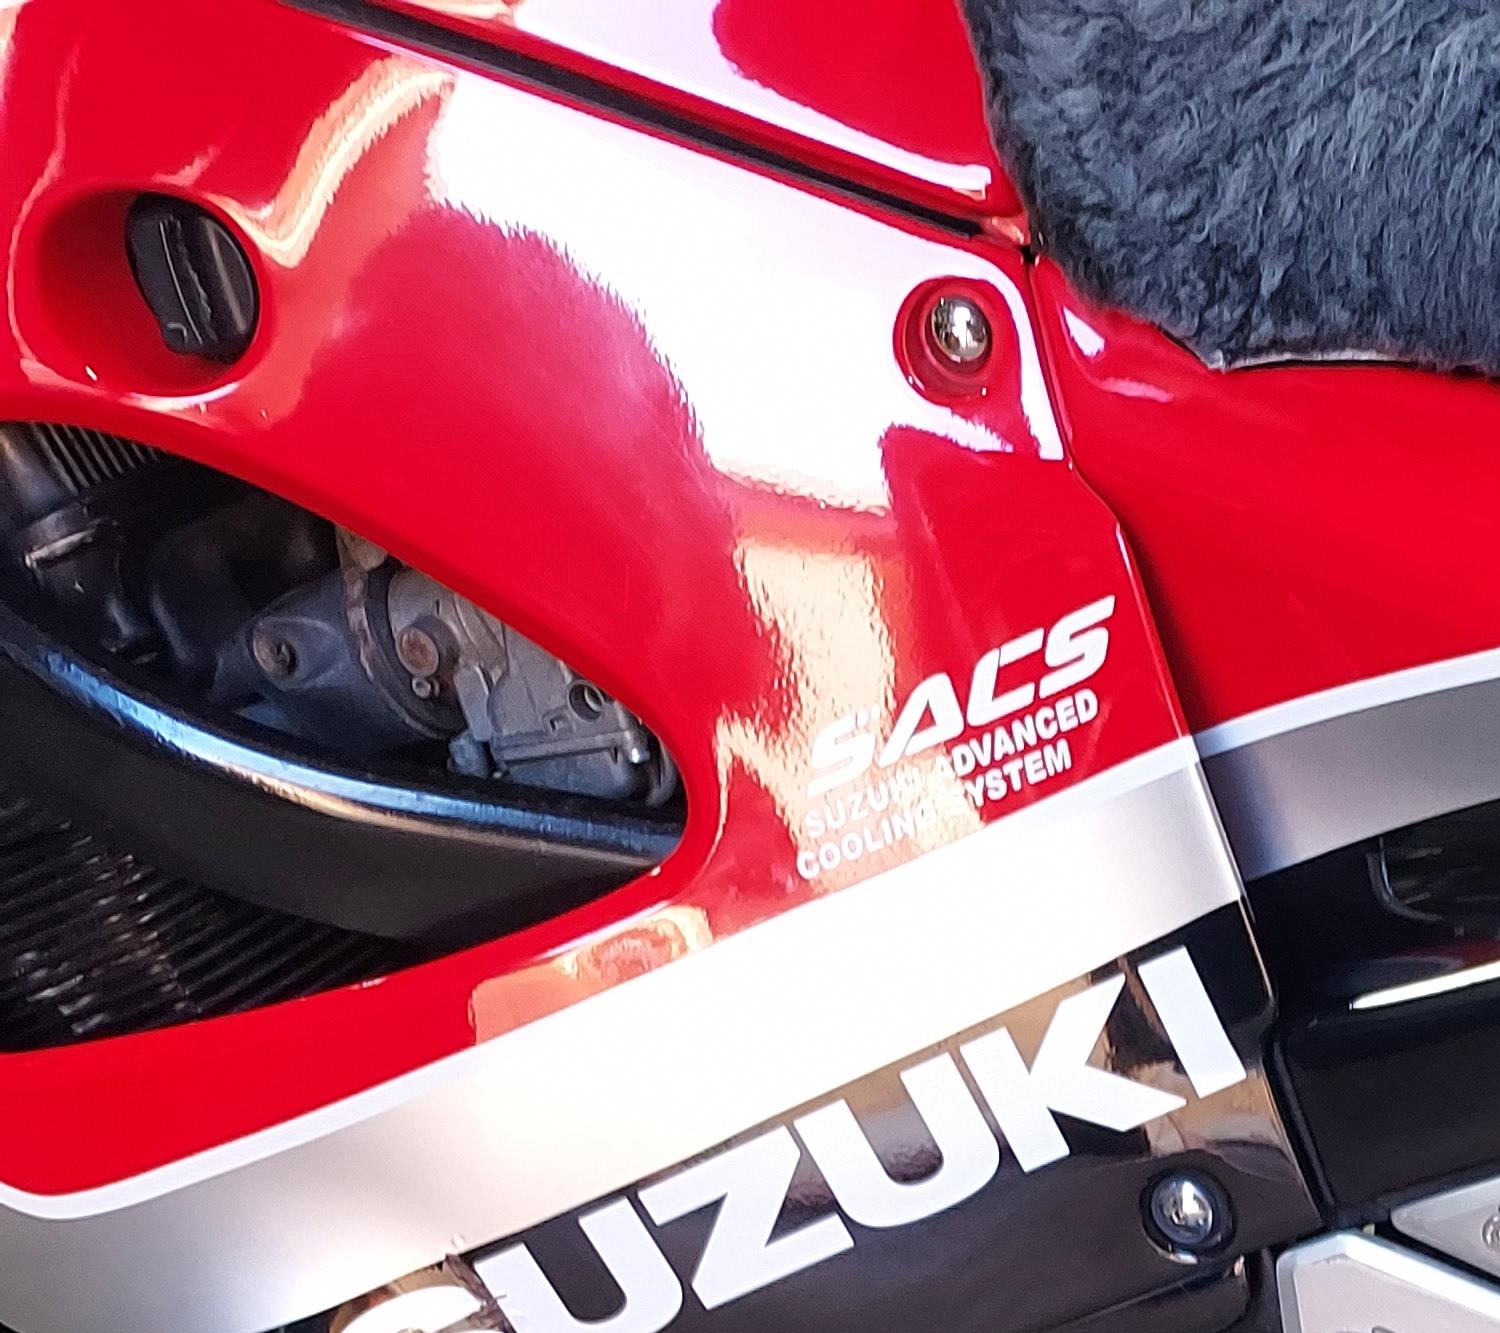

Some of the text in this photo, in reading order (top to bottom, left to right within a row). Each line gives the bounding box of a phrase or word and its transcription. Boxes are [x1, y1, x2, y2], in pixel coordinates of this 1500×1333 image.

[806, 688, 1098, 838] SUZUKI ADVANCED
[808, 595, 1115, 796] SACS
[796, 800, 938, 881] COOLING
